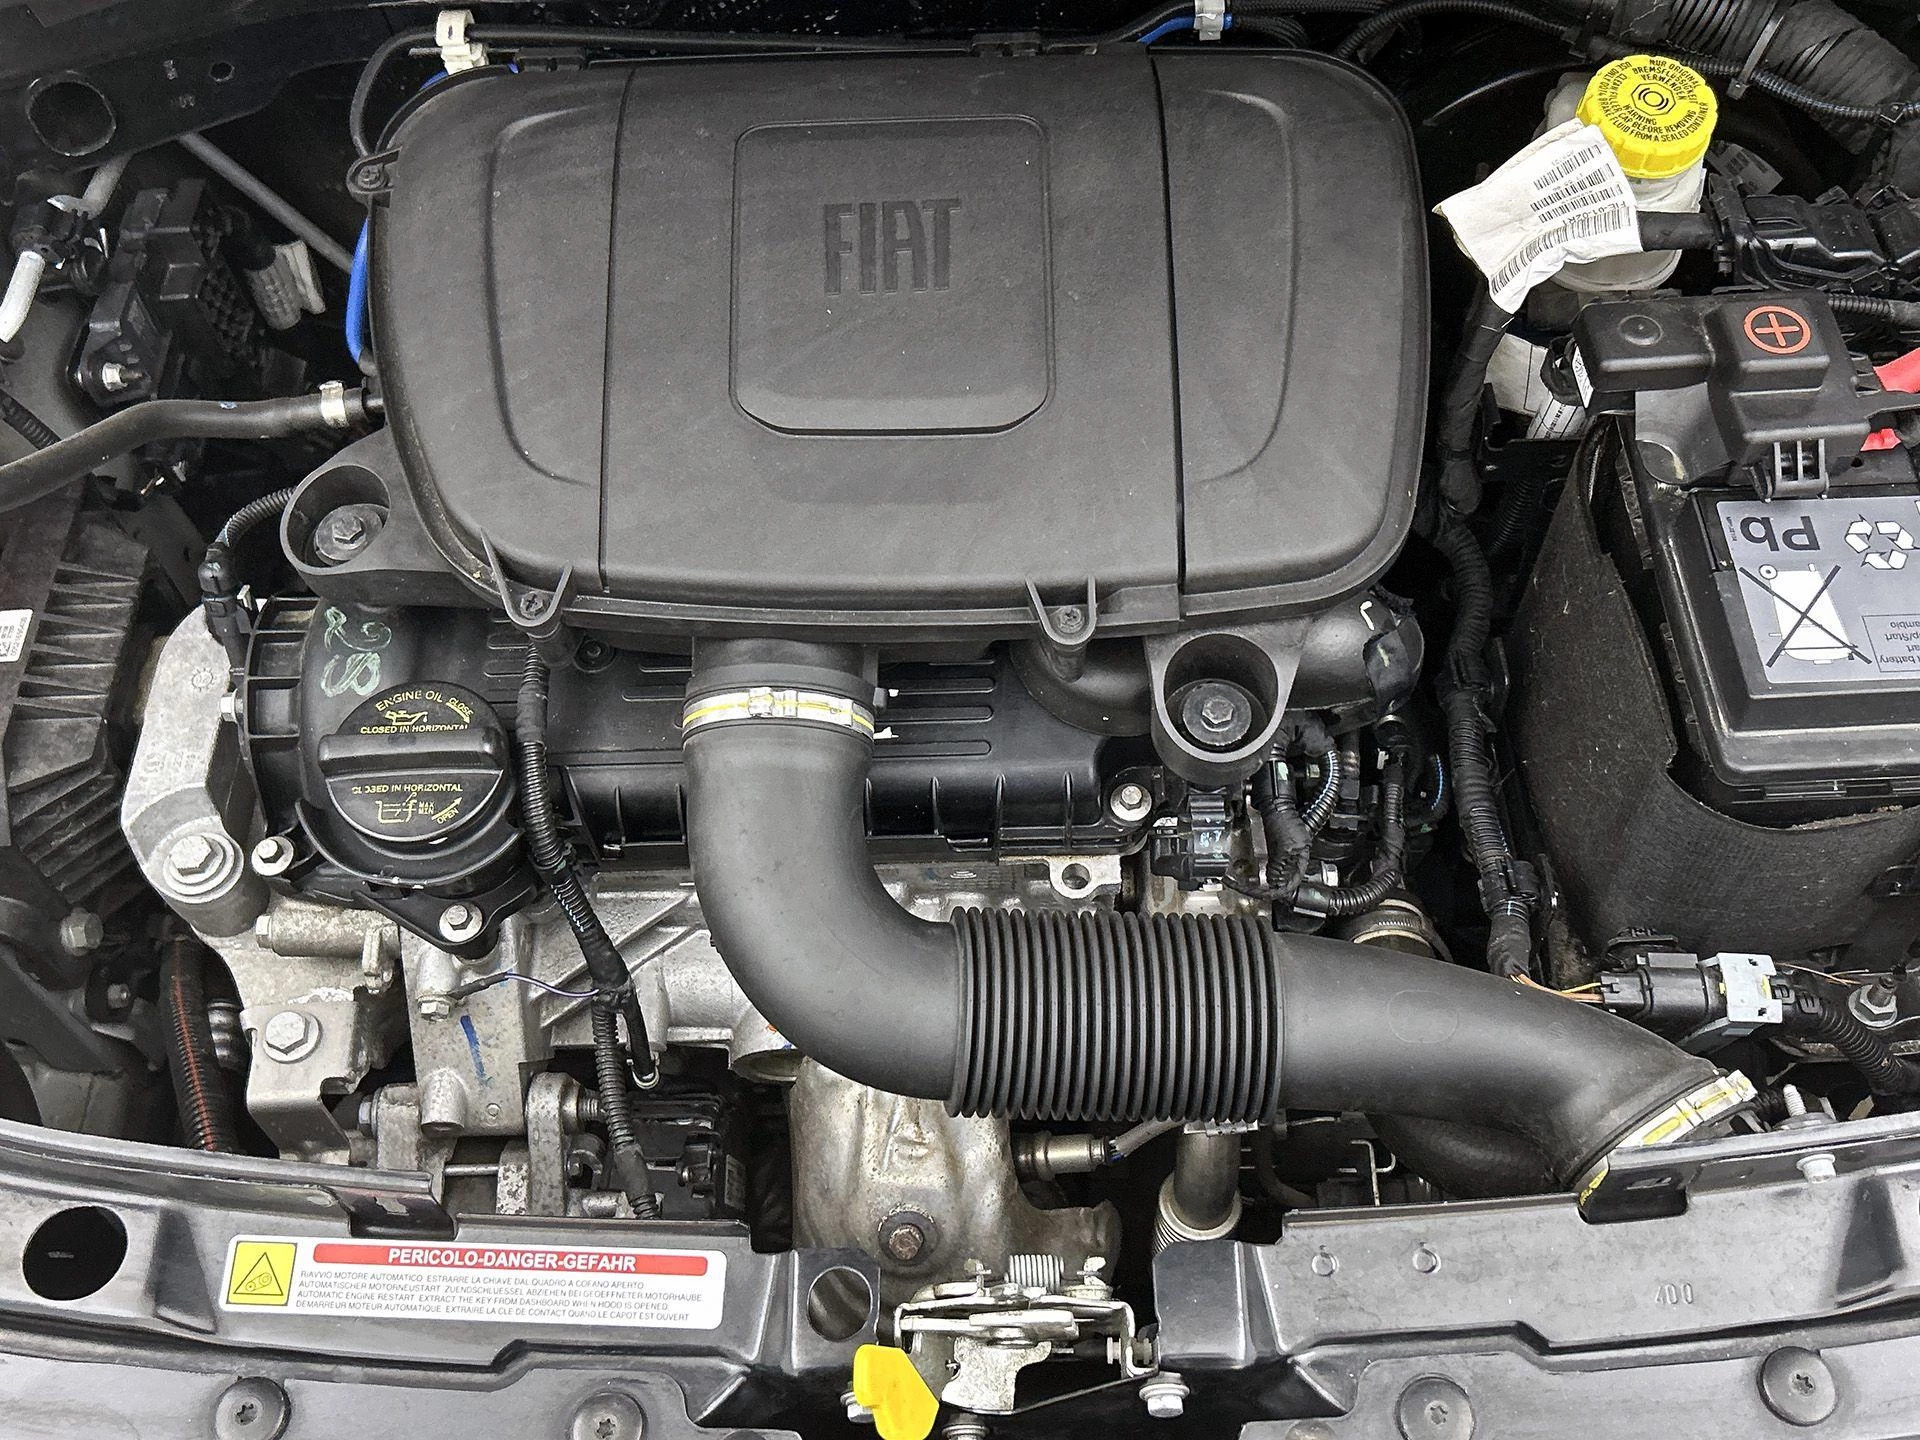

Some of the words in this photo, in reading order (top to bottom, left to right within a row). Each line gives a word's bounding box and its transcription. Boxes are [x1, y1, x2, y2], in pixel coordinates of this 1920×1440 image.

[1649, 59, 1667, 67] NUR
[1668, 63, 1701, 89] ORIGINAL
[1640, 73, 1688, 100] VERWENDEN
[1618, 112, 1634, 123] CAP
[1631, 121, 1664, 135] BEFORE
[1664, 109, 1697, 133] REMOVING
[1623, 104, 1657, 126] WARNING
[1609, 116, 1630, 133] FLUID
[1629, 129, 1653, 141] FROM
[1661, 129, 1689, 142] SEALED
[824, 199, 961, 296] FIAT
[1740, 515, 1821, 552] Pb
[1884, 631, 1920, 642] p/Start
[1880, 654, 1916, 664] battery
[375, 690, 422, 712] ENGINE
[425, 690, 443, 703] OIL
[448, 697, 474, 717] CLOSE
[360, 725, 398, 734] CLOSED
[399, 725, 410, 733] IN
[391, 784, 402, 792] IN
[403, 783, 463, 792] HORIZONTAL
[436, 807, 459, 825] OPEN
[388, 1247, 637, 1272] PERICOLO-DANGER-GEFAHR
[298, 1280, 367, 1290] AUTOMATISCHER
[444, 1285, 525, 1296] ZUENDSCHLUESSEL
[526, 1288, 567, 1297] ABZIEHEN
[568, 1289, 582, 1298] BEI
[583, 1290, 643, 1300] GEOEFFNETER
[300, 1270, 333, 1279] RIAVVIO
[334, 1271, 369, 1281] MOTORE
[426, 1275, 469, 1284] ESTRARRE
[471, 1276, 481, 1284] LA
[483, 1276, 513, 1286] CHIAVE
[514, 1277, 530, 1287] DAL
[531, 1278, 567, 1287] QUADRO
[568, 1279, 574, 1287] A
[575, 1280, 610, 1289] COFANO
[295, 1300, 347, 1309] DEMARREUR
[347, 1302, 383, 1311] MOTEUR
[445, 1305, 484, 1314] EXTRAIRE
[486, 1306, 497, 1315] LA
[497, 1307, 515, 1316] CLE
[515, 1308, 527, 1316] DE
[528, 1308, 567, 1317] CONTACT
[567, 1309, 597, 1318] QUAND
[597, 1310, 608, 1319] LE
[609, 1310, 638, 1320] CAPOT
[638, 1311, 655, 1321] EST
[656, 1312, 690, 1321] OUVERT
[297, 1290, 344, 1299] AUTOMATIC
[345, 1291, 375, 1300] ENGINE
[418, 1294, 456, 1303] EXTRACT
[458, 1296, 474, 1304] THE
[475, 1297, 493, 1305] KEY
[493, 1297, 518, 1306] FROM
[519, 1298, 571, 1307] DASHBOARD
[571, 1300, 597, 1308] WHEN
[597, 1300, 623, 1309] HOOD
[624, 1302, 632, 1310] IS
